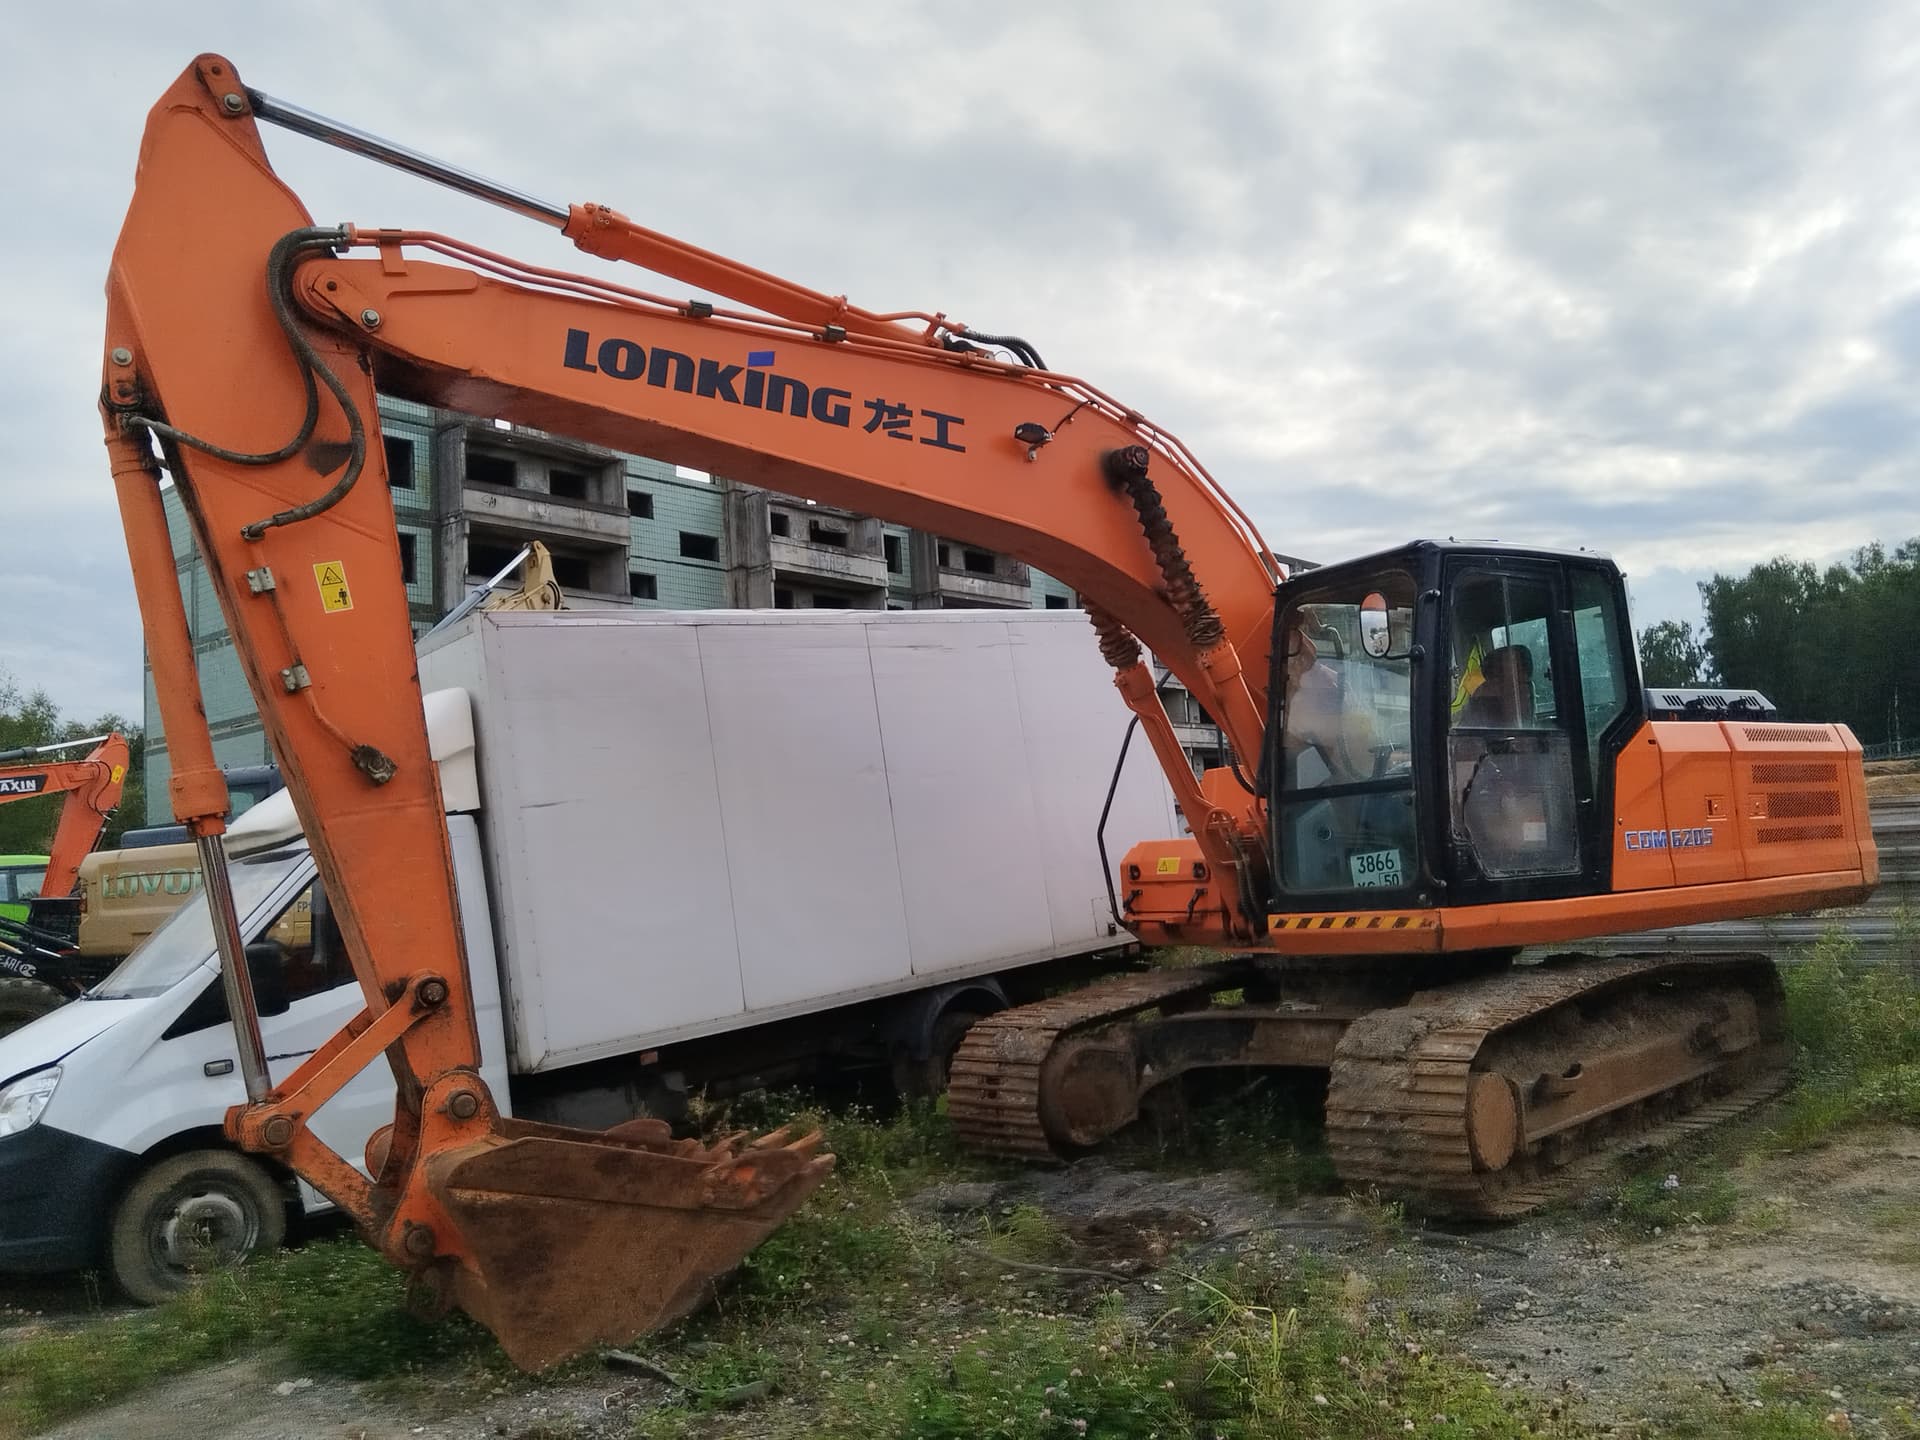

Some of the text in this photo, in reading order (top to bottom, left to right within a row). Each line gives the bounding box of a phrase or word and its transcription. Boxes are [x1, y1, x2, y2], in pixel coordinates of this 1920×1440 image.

[862, 398, 966, 453] 龙工
[1356, 852, 1394, 873] 3866
[1384, 873, 1399, 887] 50
